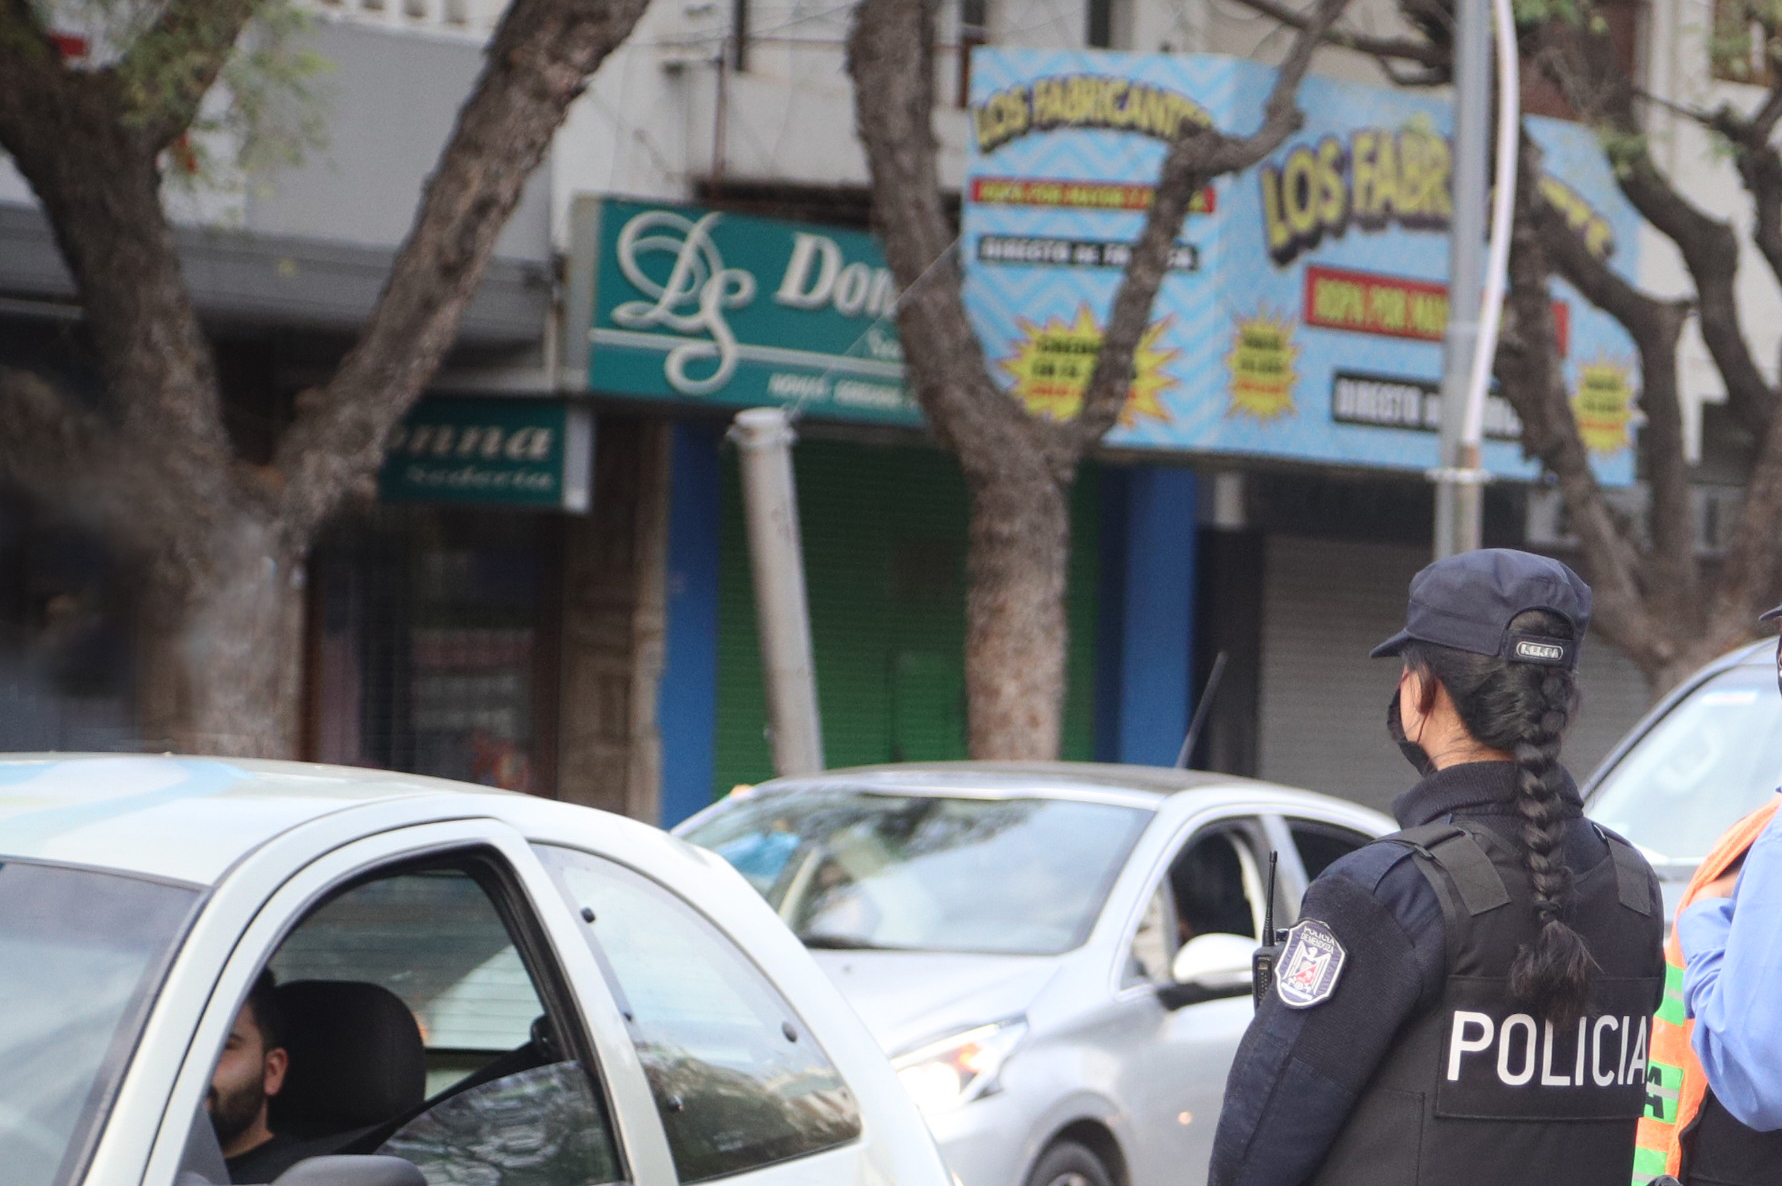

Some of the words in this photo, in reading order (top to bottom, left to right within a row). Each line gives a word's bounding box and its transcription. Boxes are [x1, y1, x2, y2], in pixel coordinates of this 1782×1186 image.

[973, 84, 1031, 152] LOS
[1260, 136, 1350, 265] LOS
[1447, 1010, 1647, 1087] POLICIA
